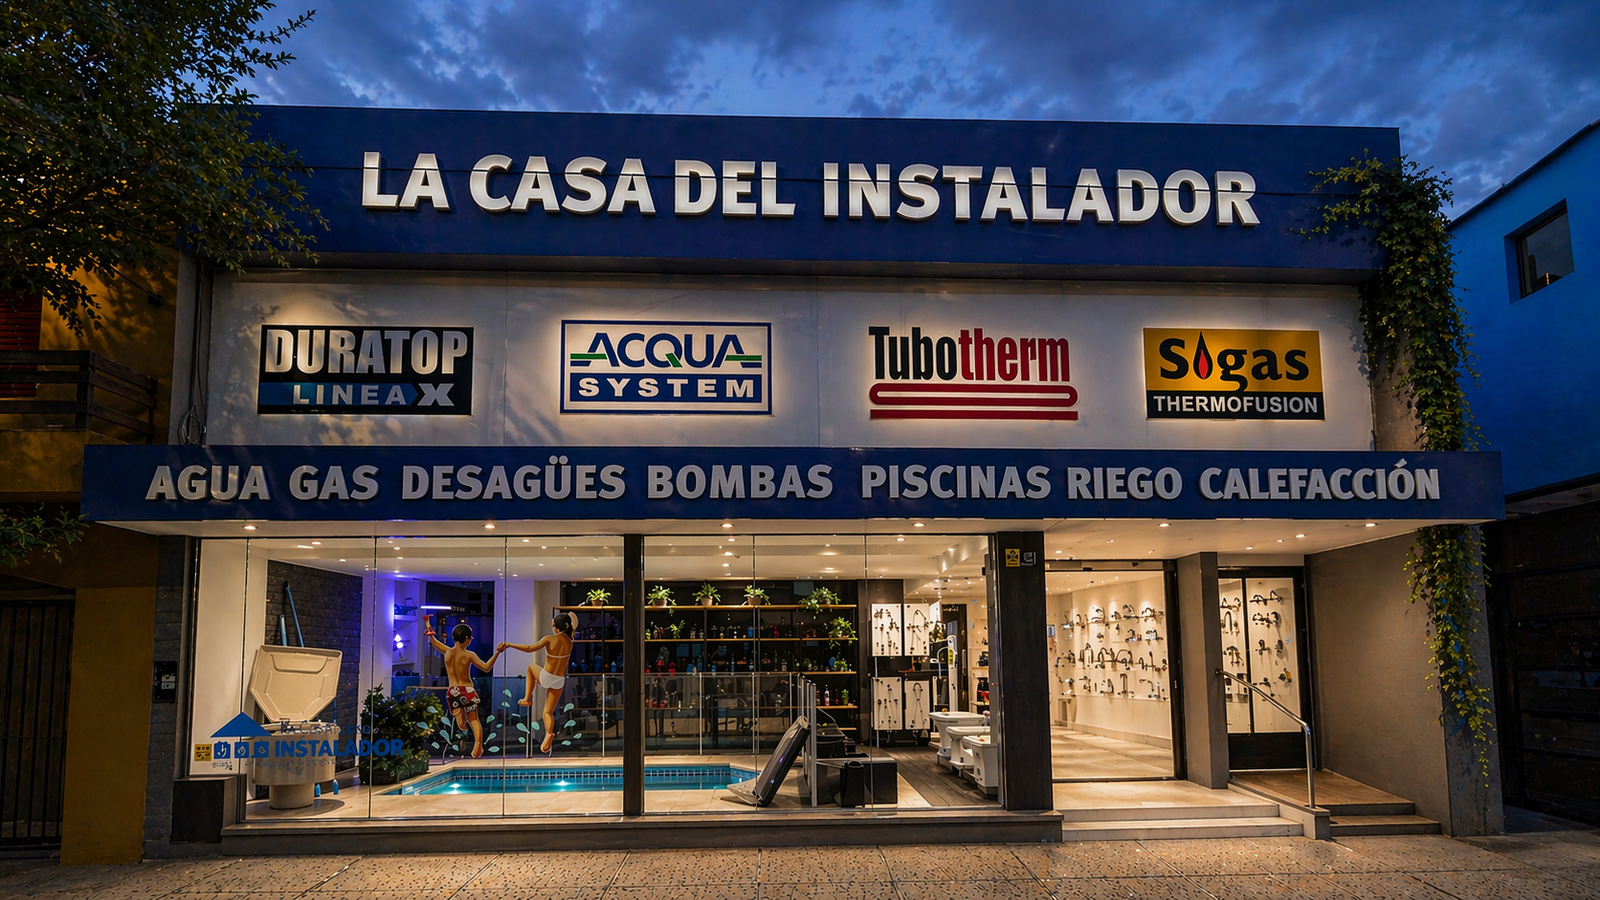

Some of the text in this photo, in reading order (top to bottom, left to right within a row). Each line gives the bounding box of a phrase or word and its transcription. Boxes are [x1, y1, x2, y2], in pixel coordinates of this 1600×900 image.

[362, 151, 1260, 226] LA CASA DEL INSTALADOR
[265, 329, 468, 375] DURATOP
[570, 332, 762, 369] ACQUA
[868, 326, 1071, 382] Tubotherm
[292, 383, 455, 406] LINEA X
[578, 377, 754, 398] SYSTEM
[1153, 395, 1318, 413] THERMOFUSION
[145, 455, 1441, 500] AGUA GAS DESAGÜES BOMBAS PISCINAS RIEGO CALEFACCIÓN
[274, 738, 405, 758] INSTALADOR
